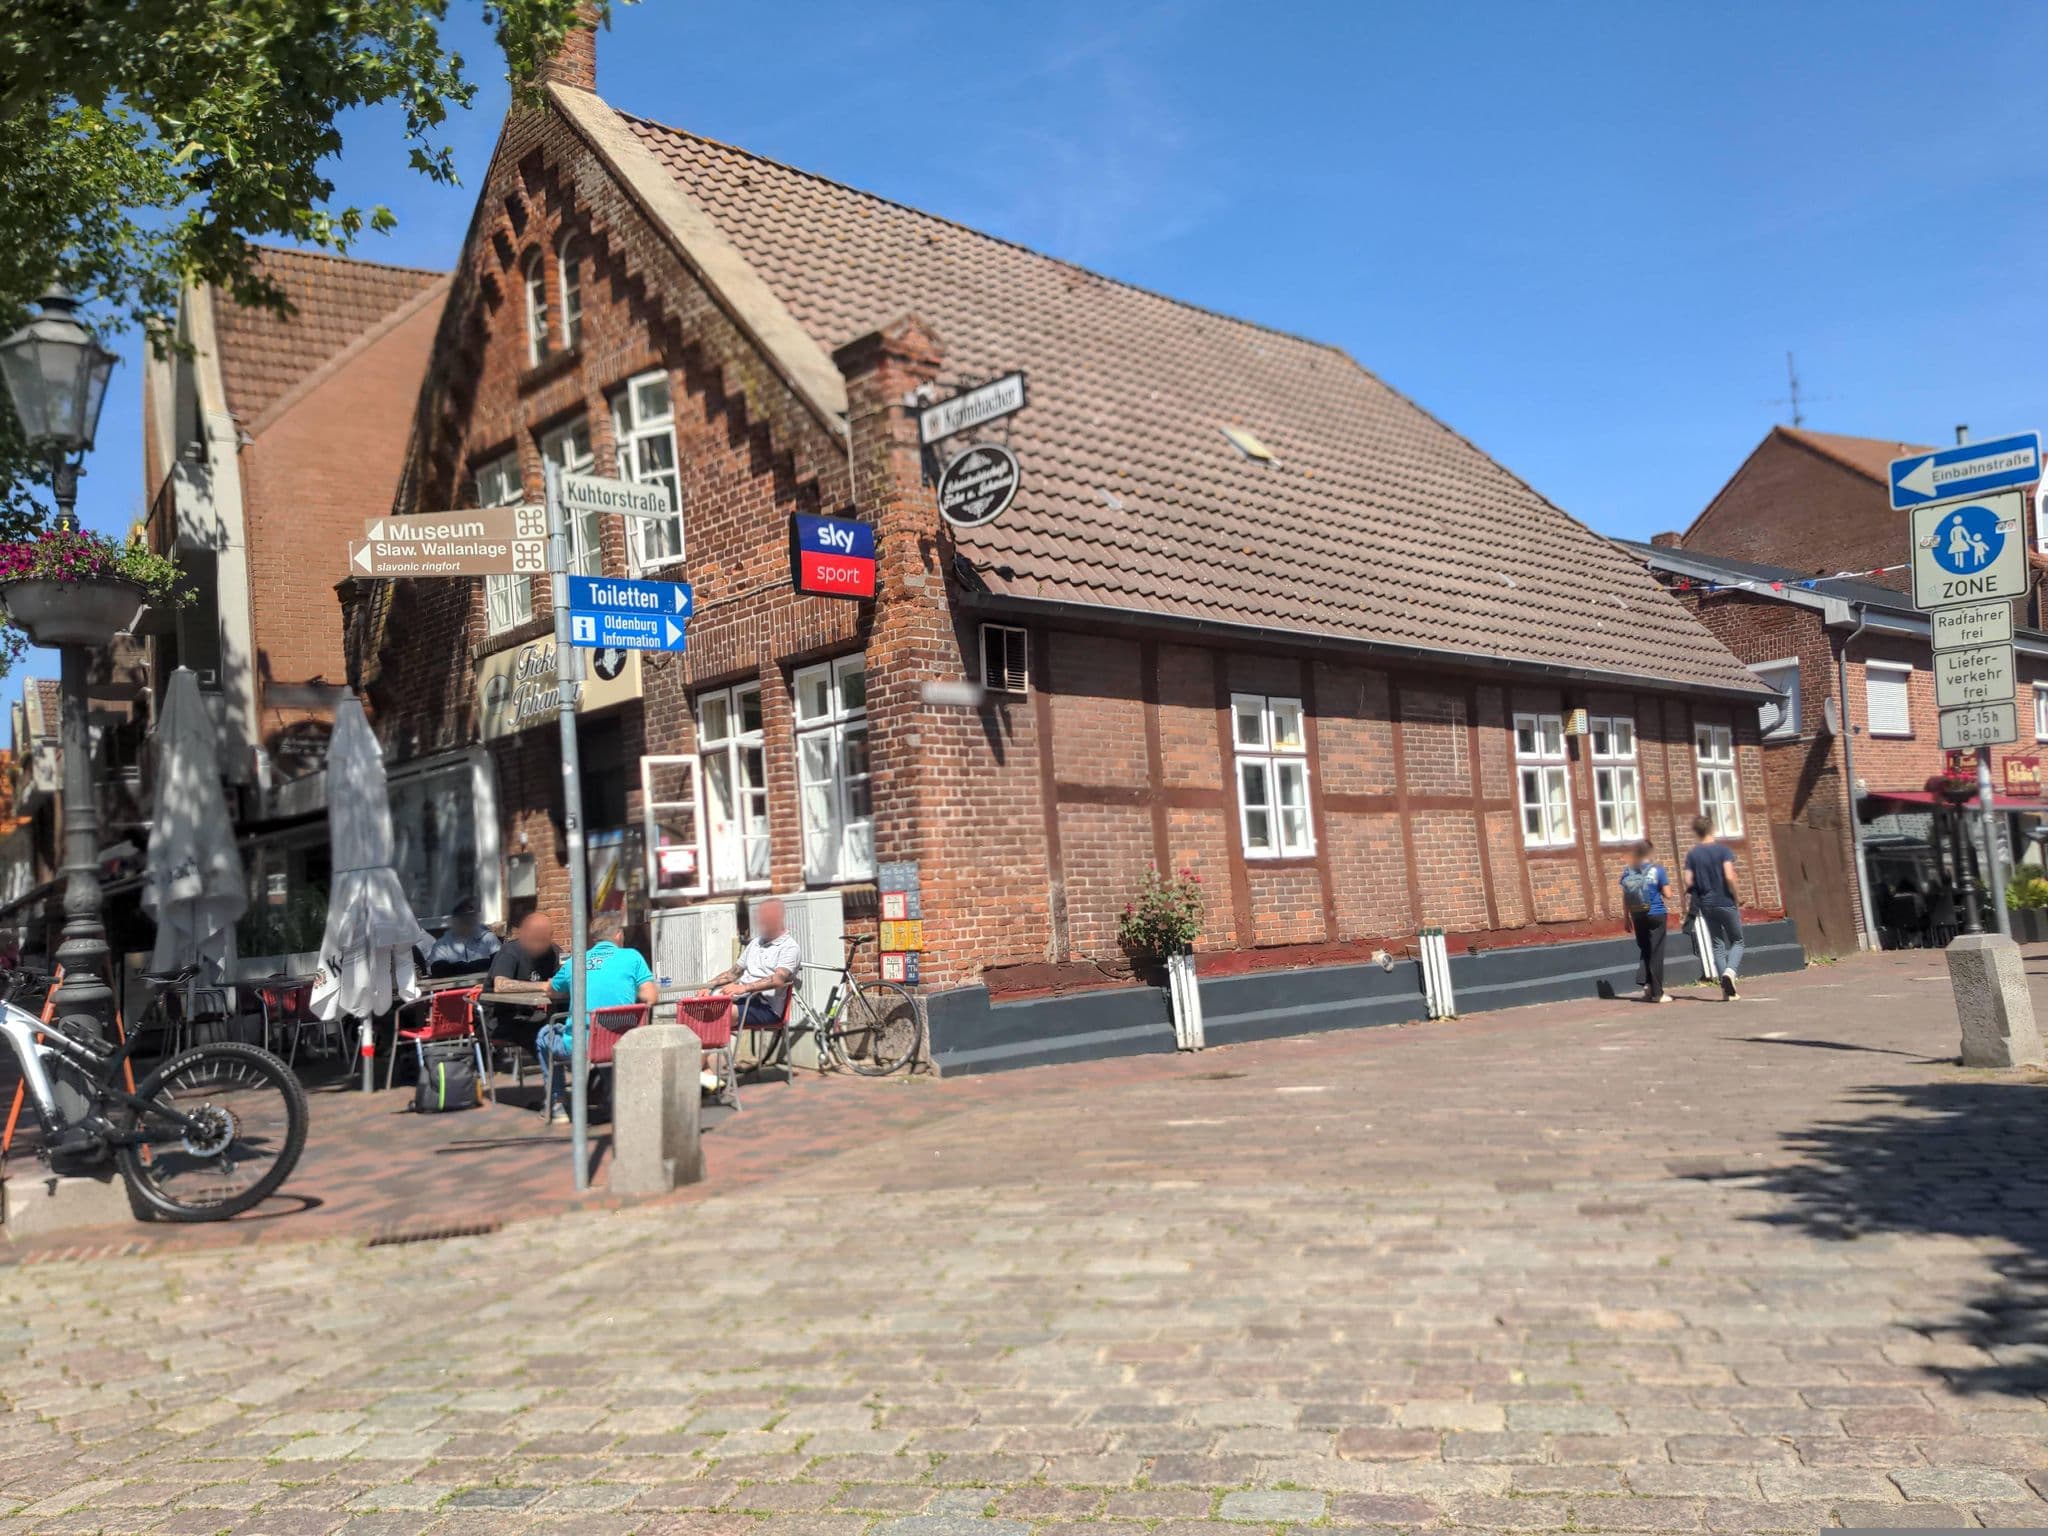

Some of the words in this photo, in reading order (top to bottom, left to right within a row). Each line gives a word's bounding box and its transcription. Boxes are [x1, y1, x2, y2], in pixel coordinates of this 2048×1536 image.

[1932, 454, 2030, 482] Einbahnstraße
[567, 480, 667, 514] Kuhtorstraße
[388, 520, 485, 542] Museum
[817, 523, 854, 553] sky
[376, 543, 417, 557] Slaw.
[422, 542, 507, 558] Wallanlage
[376, 562, 419, 572] slavonic
[421, 561, 461, 573] ringfort
[817, 565, 860, 584] sport
[589, 583, 659, 608] Toiletten
[1943, 575, 1998, 599] ZONE
[604, 615, 658, 634] Oldenburg
[1938, 610, 2004, 628] Radfahrer
[602, 634, 661, 648] Information
[1961, 628, 1983, 641] frei
[1949, 655, 1998, 670] Liefer-
[1946, 668, 2003, 685] verkehr
[1963, 684, 1988, 699] frei
